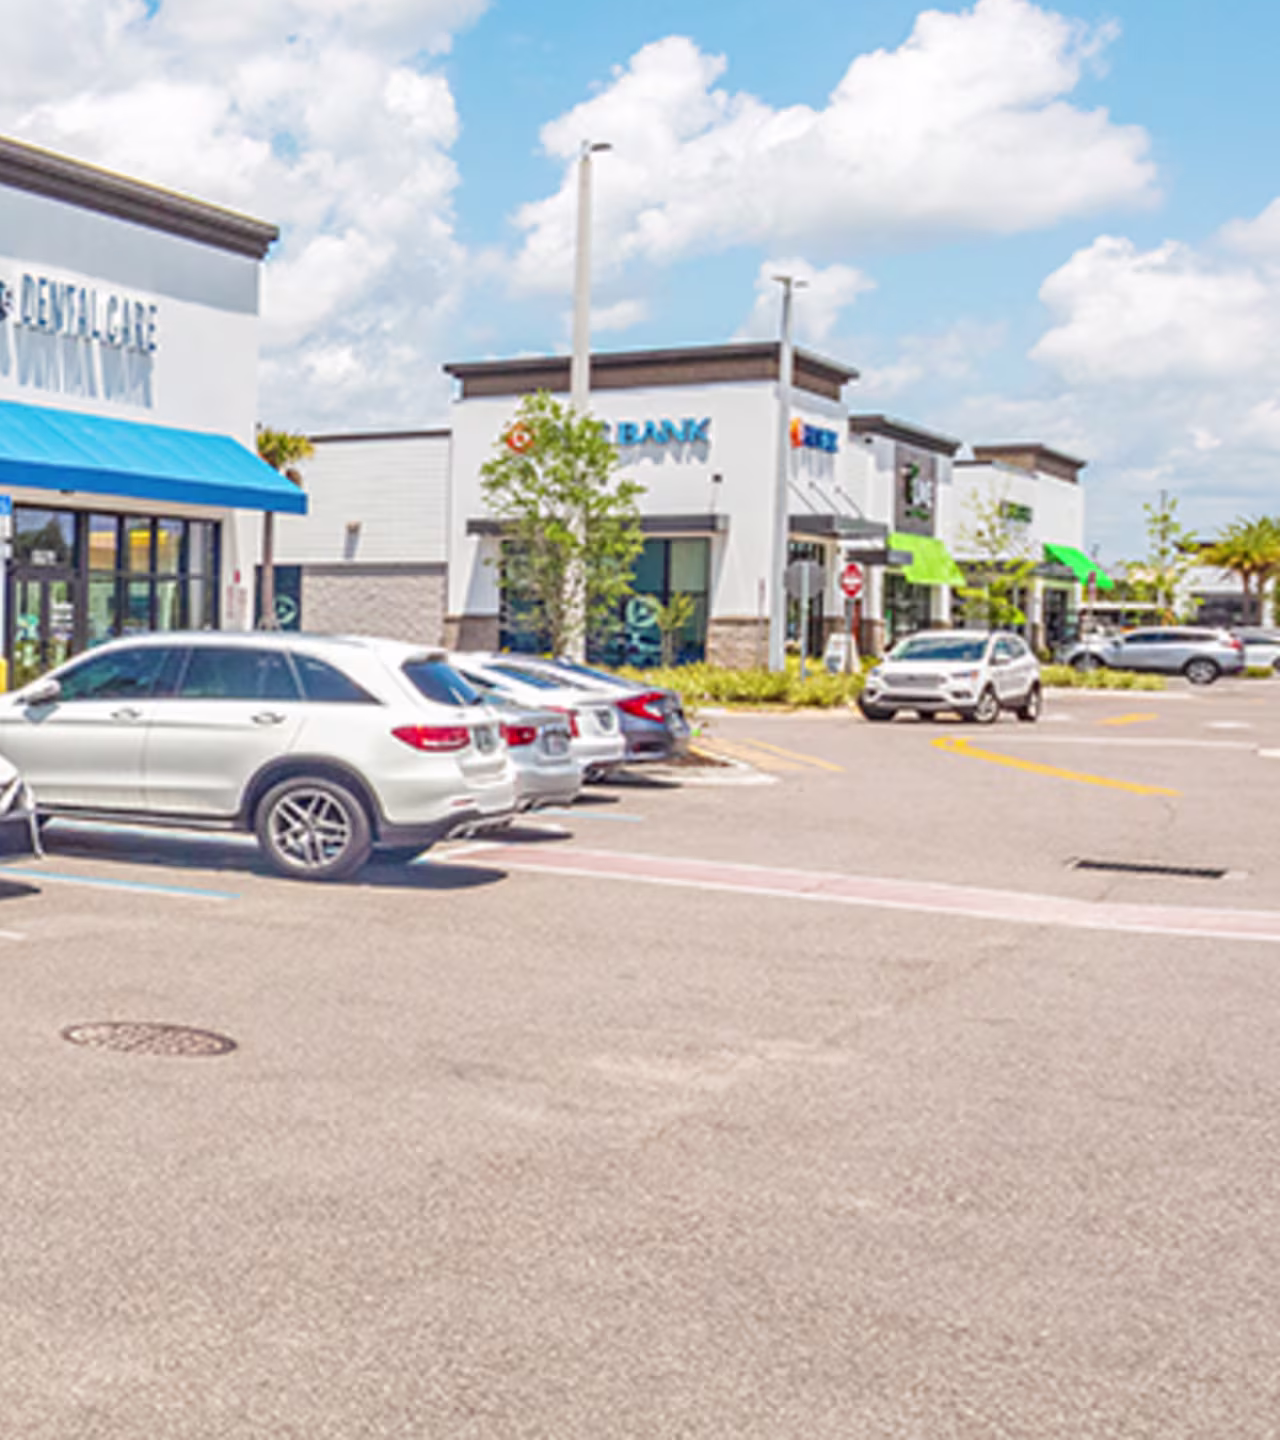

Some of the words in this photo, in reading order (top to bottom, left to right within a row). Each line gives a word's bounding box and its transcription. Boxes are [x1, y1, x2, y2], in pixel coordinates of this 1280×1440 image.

[21, 273, 101, 340] DENTAL
[106, 294, 158, 354] CARE
[616, 416, 711, 446] BANK
